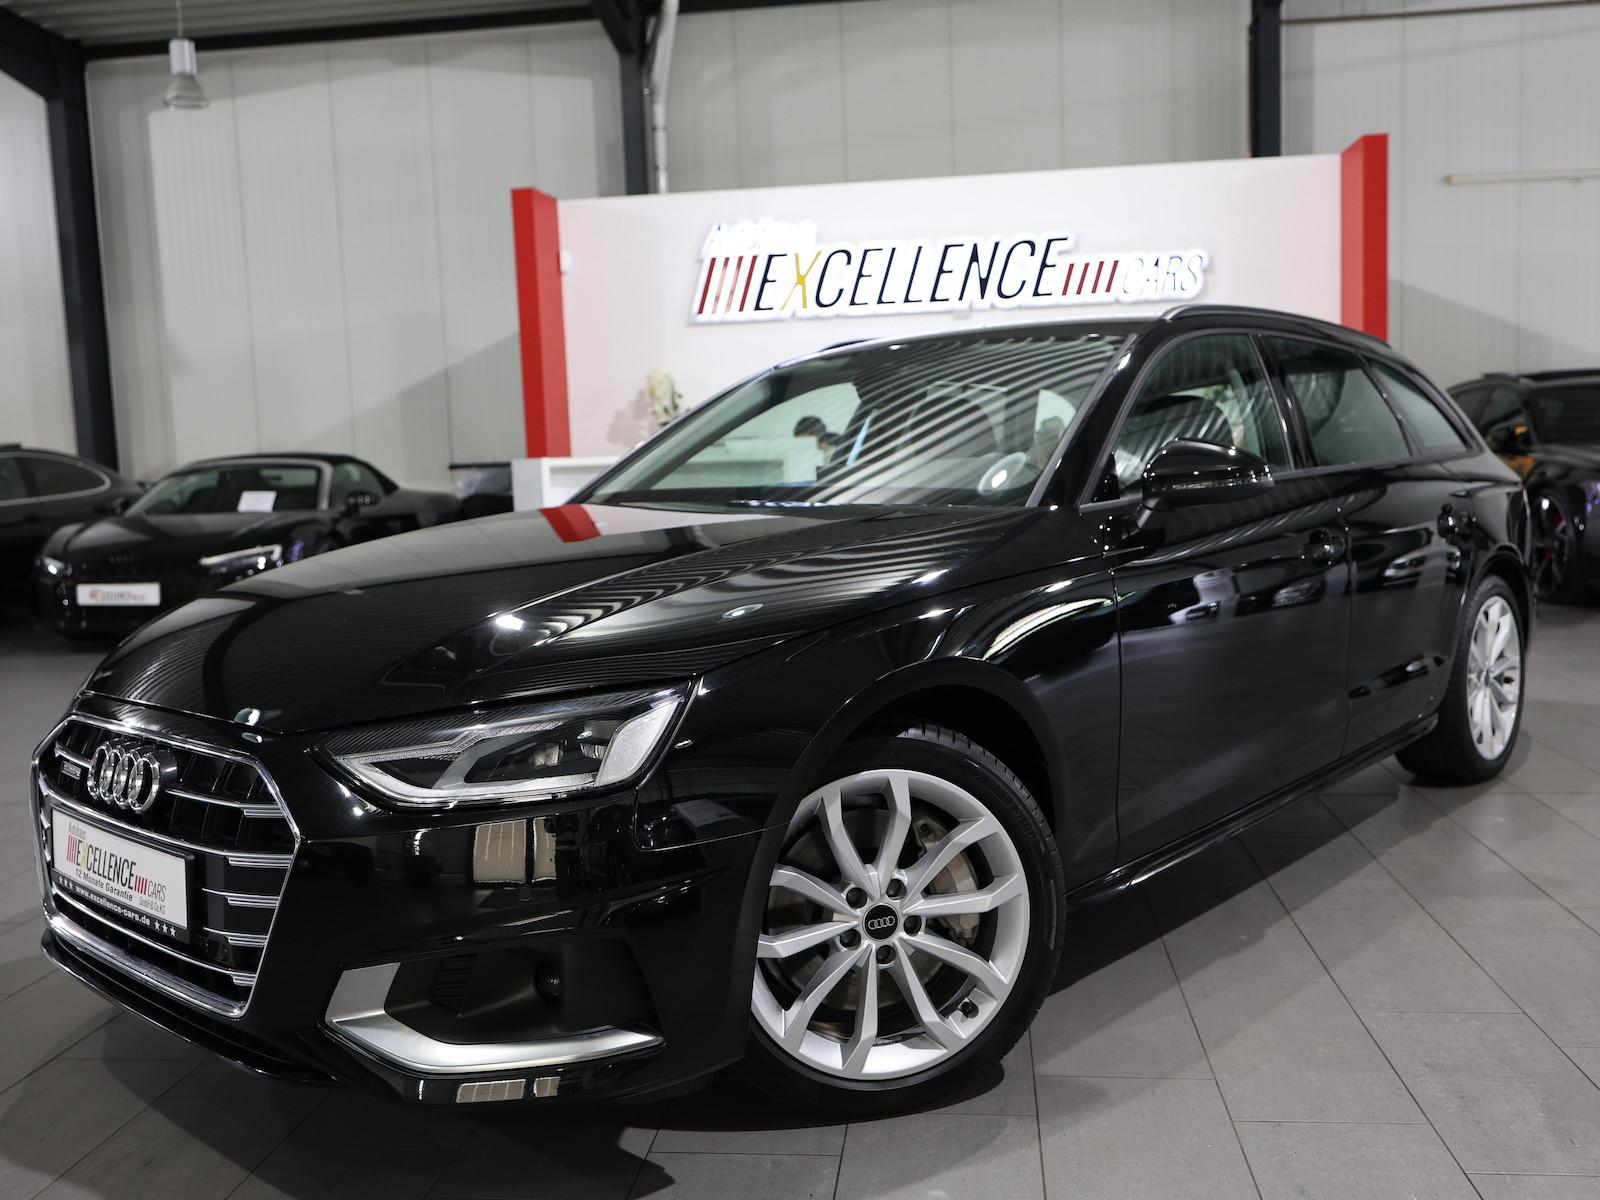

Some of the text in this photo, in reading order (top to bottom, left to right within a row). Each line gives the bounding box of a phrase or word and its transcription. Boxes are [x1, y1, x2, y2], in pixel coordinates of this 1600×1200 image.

[754, 237, 1203, 312] EXCELLENCE CARS
[75, 868, 133, 902] 12 Monate Garantie
[76, 839, 167, 903] EXCELLENCE CARS
[75, 885, 151, 926] www.excellence-cars.de
